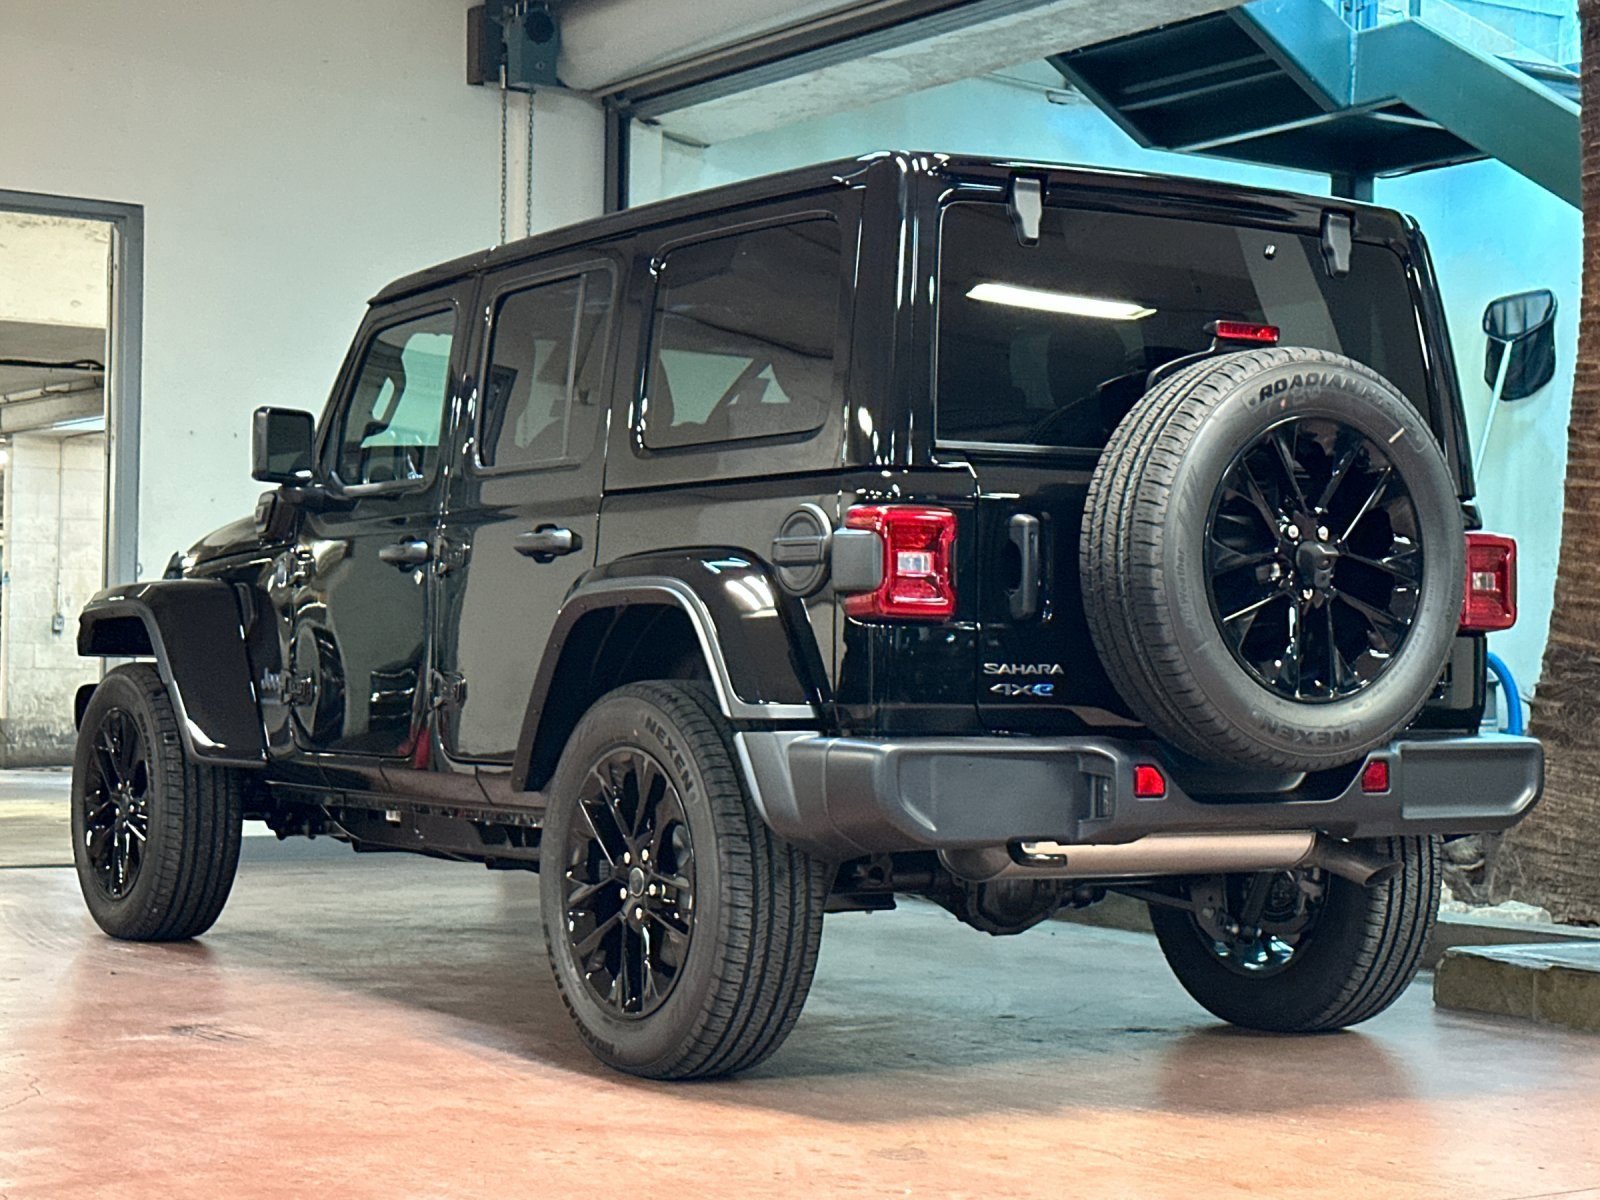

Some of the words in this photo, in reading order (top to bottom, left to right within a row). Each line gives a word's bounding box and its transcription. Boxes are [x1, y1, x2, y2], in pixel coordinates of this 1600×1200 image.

[983, 662, 1064, 675] SAHARA
[1261, 717, 1351, 745] NEXEN
[644, 716, 694, 792] NEXEN
